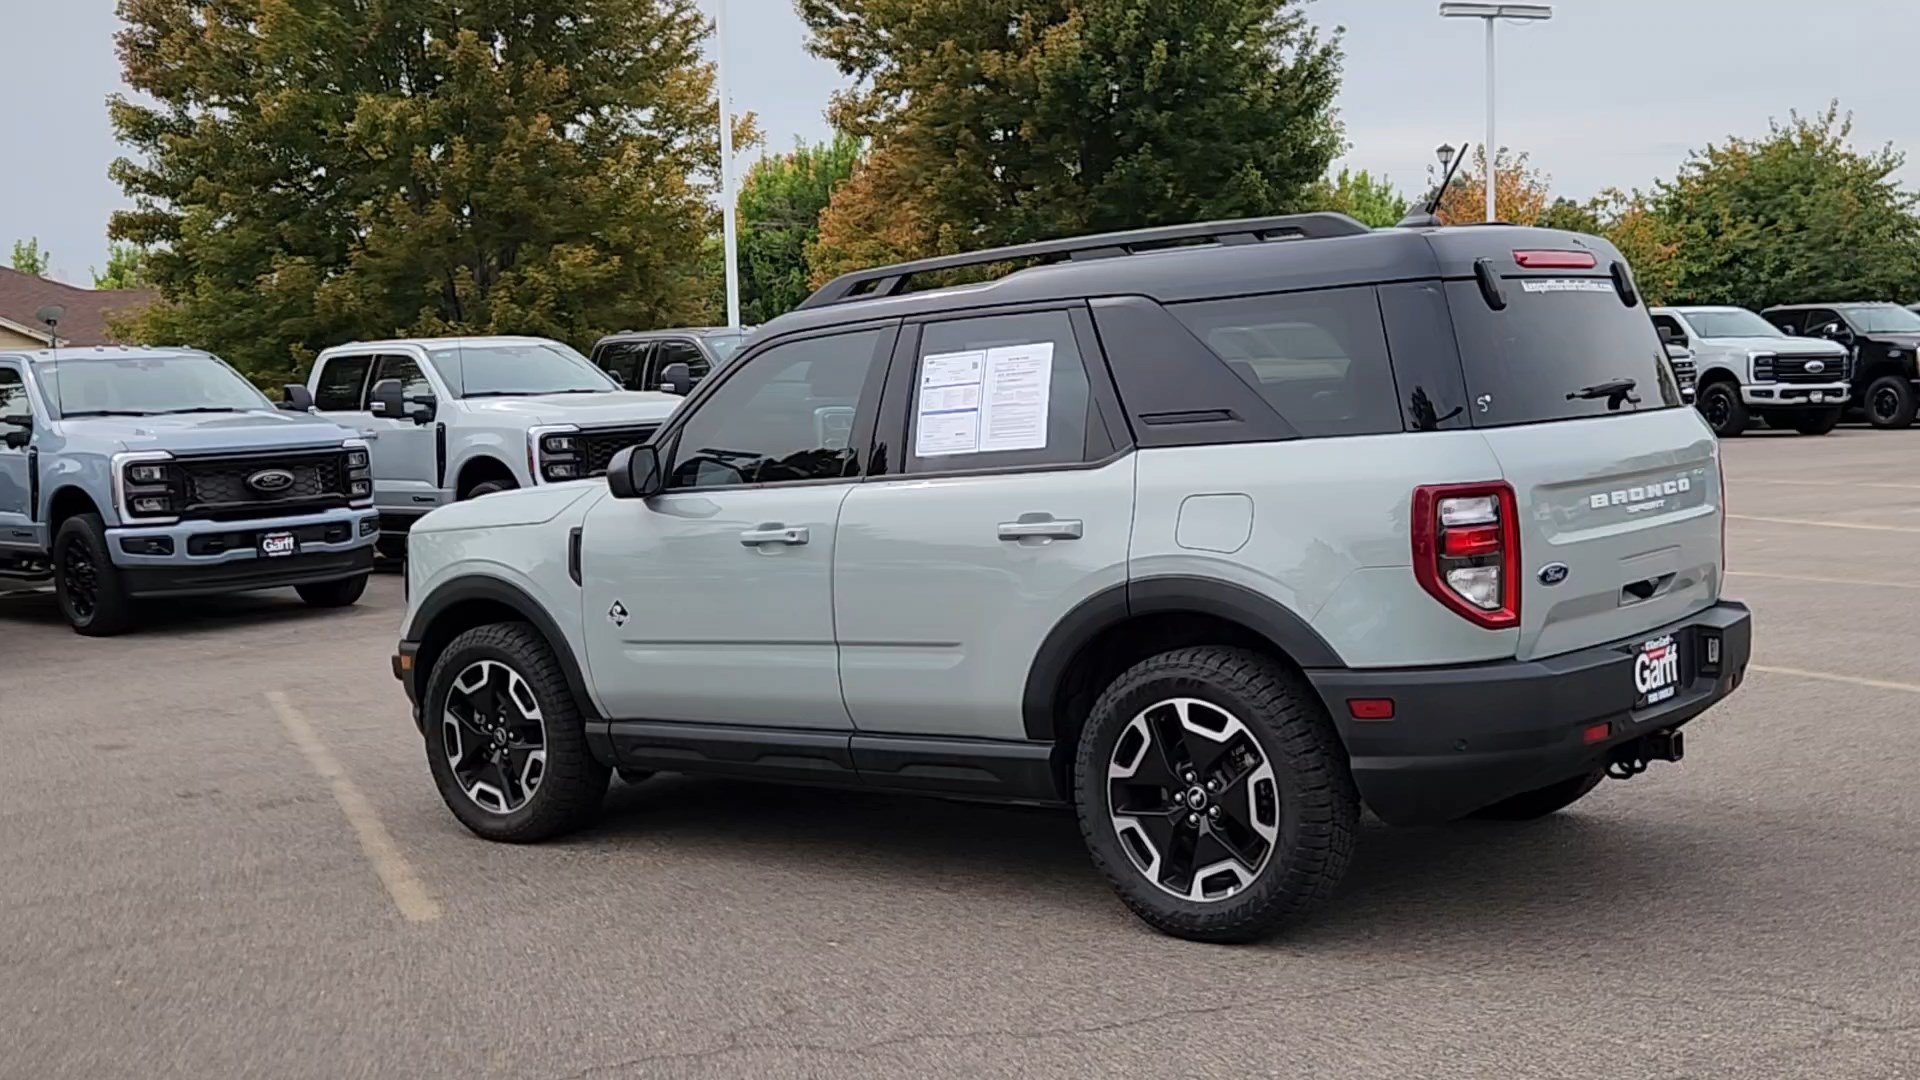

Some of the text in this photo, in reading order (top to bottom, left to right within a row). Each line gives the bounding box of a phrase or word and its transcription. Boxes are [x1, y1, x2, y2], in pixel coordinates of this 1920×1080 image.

[1590, 478, 1690, 508] BRONCO
[1626, 499, 1665, 513] SPORT
[263, 536, 295, 552] Garff
[1635, 643, 1678, 693] Garff
